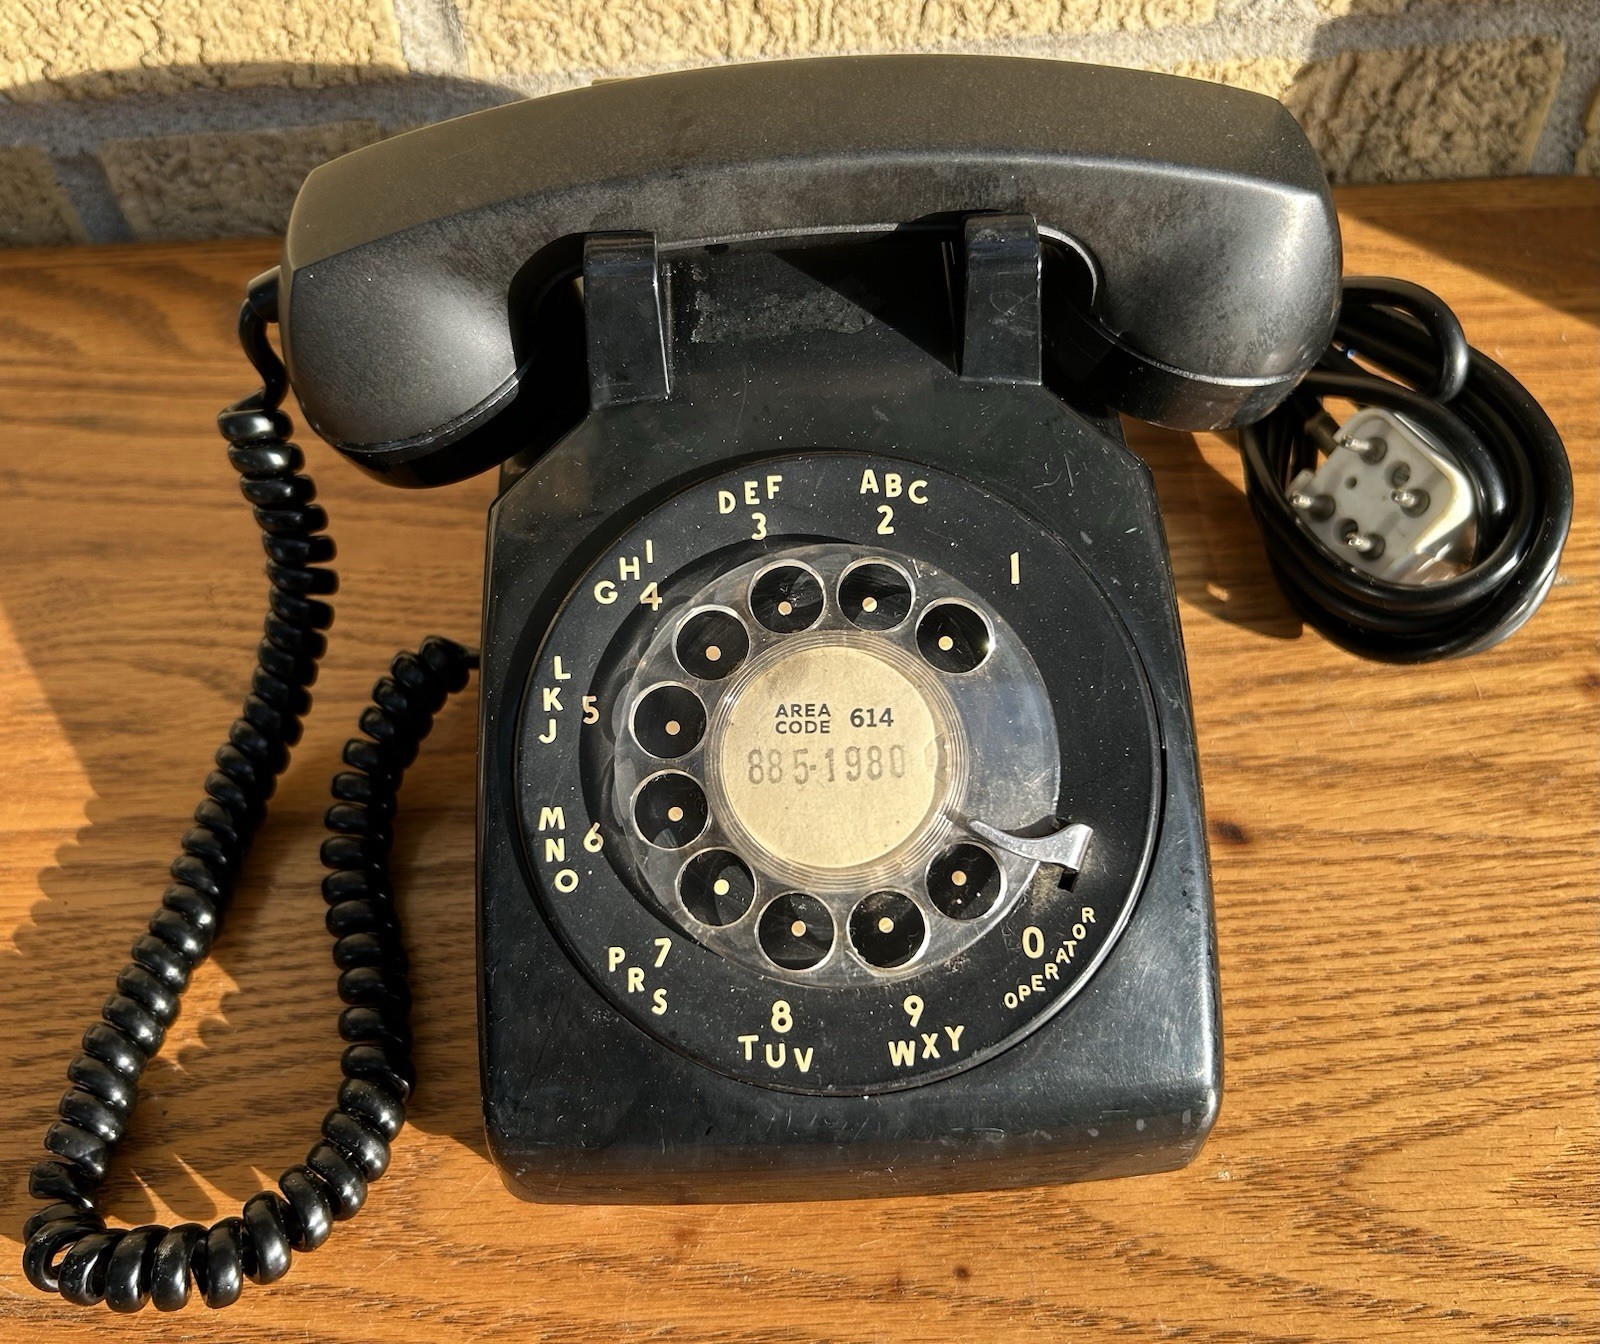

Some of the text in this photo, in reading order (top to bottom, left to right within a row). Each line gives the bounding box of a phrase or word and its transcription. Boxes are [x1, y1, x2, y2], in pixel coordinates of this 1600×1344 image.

[717, 474, 782, 514] DEF
[859, 468, 928, 506] ABC
[751, 511, 768, 541] 3
[876, 504, 895, 536] 2
[639, 581, 664, 612] 4
[581, 695, 600, 725] 5
[775, 703, 832, 718] AREA
[850, 707, 894, 728] 614
[775, 720, 831, 735] CODE
[582, 821, 604, 853] 6
[654, 937, 672, 967] 7
[1003, 905, 1096, 1010] OPERATOR
[770, 999, 793, 1033] 8
[903, 994, 924, 1027] 9
[737, 1034, 814, 1073] TUV
[888, 1025, 966, 1067] WXY
